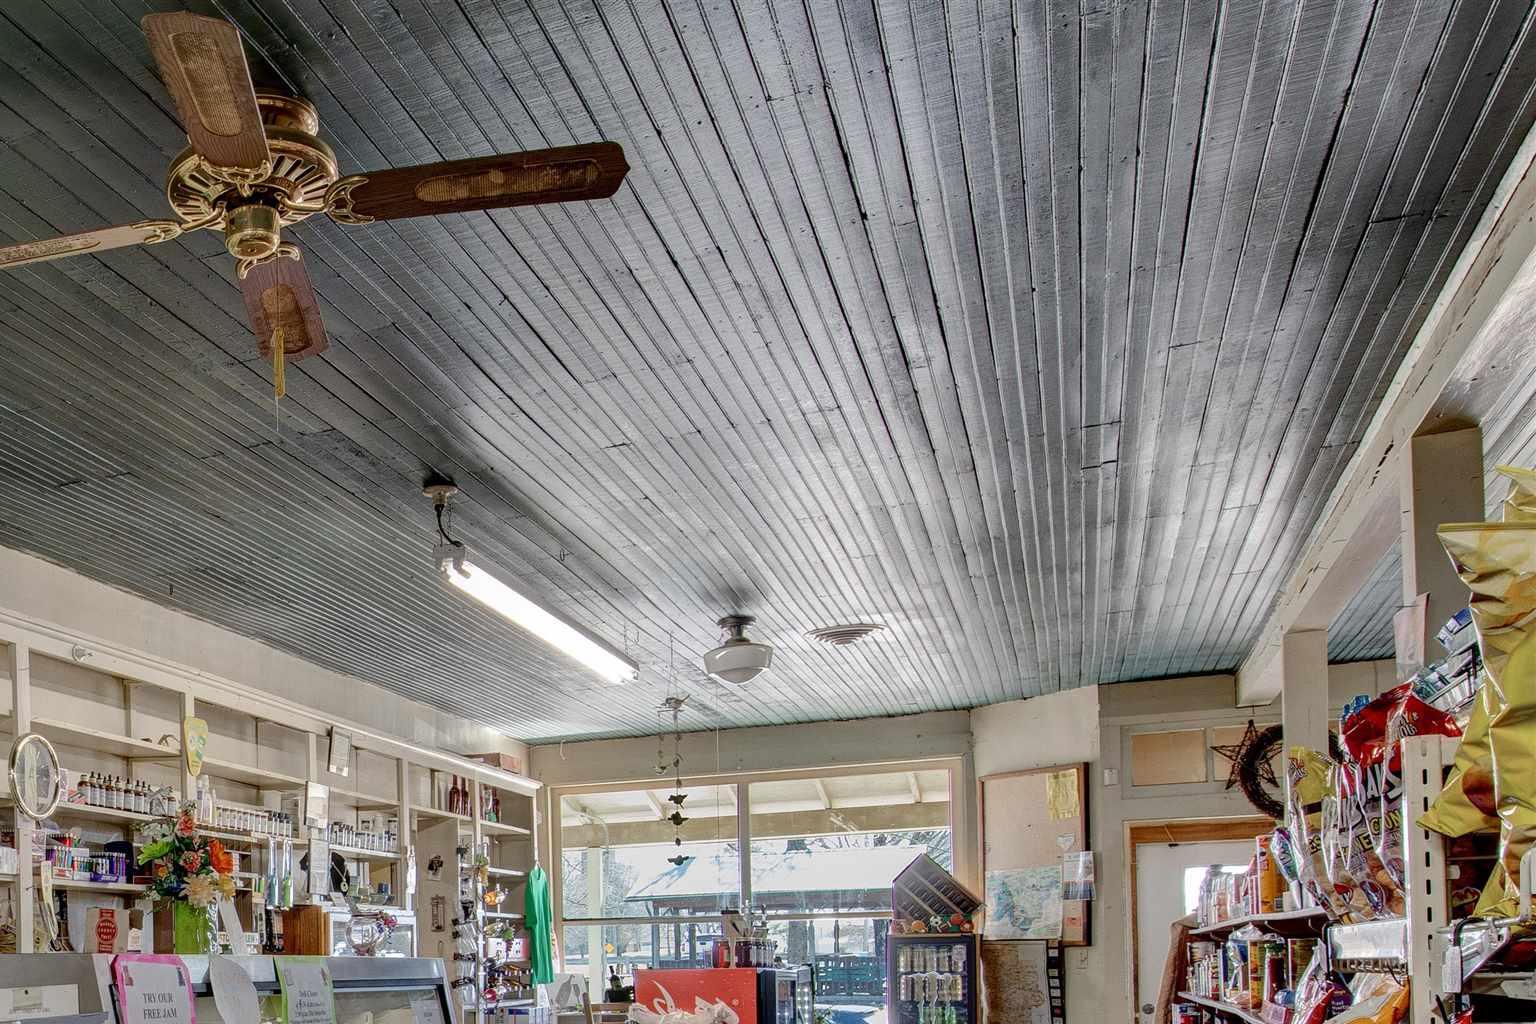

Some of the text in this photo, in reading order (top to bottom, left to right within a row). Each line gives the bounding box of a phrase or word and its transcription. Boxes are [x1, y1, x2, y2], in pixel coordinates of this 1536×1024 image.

[142, 992, 174, 1004] TRY OUR
[143, 1008, 178, 1020] FREE JAM
